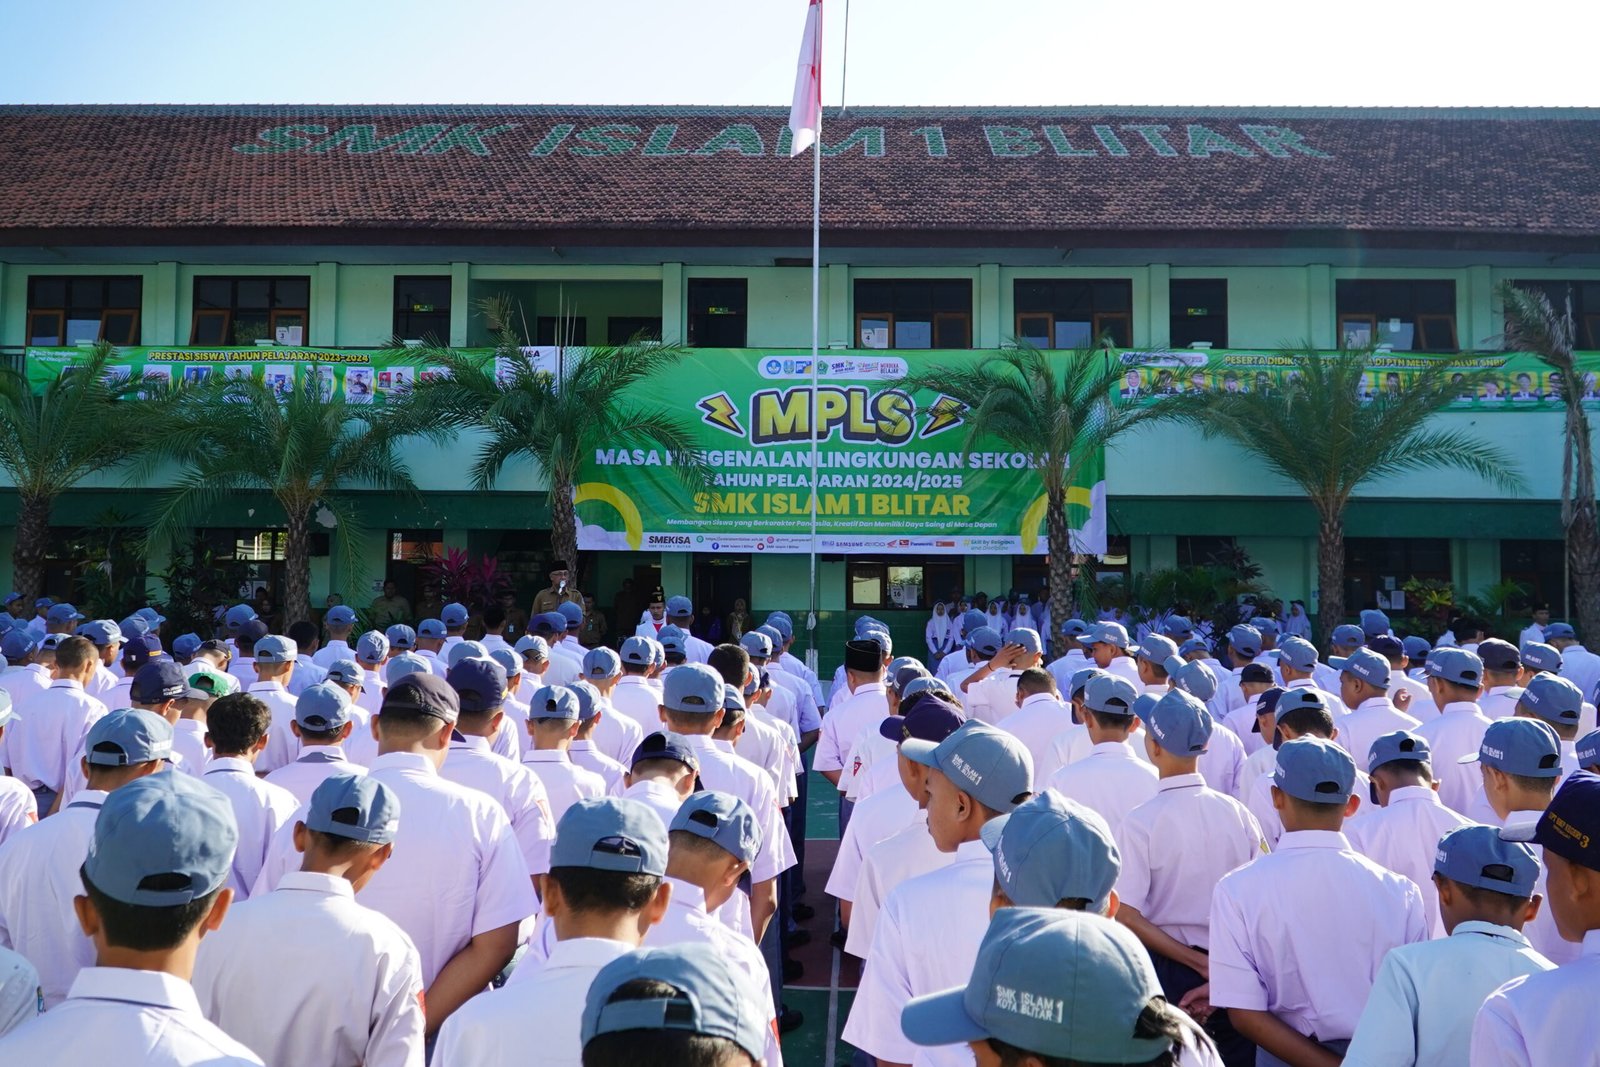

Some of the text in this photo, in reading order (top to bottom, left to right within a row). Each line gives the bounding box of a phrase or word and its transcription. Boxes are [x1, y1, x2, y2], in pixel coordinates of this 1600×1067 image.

[232, 123, 1336, 159] SMK ISLAM 1 BLITAR
[148, 351, 369, 363] PRESTASI SISWA TAHUN PELAJARAN 2023-2024
[1224, 355, 1266, 365] PESERTA
[1267, 356, 1294, 366] DIDIK
[1375, 358, 1385, 366] DI
[1386, 358, 1405, 366] PTN
[1406, 359, 1443, 367] MELAL
[831, 361, 845, 370] SMK
[753, 387, 914, 445] MPLS
[595, 449, 1070, 469] MASA PNGENALAN LINGKUNGAN SEKOL
[766, 473, 869, 488] PELAJARAN
[871, 471, 964, 492] 2024/2025
[693, 492, 971, 516] SMK ISLAM 1 BLITAR
[666, 519, 712, 527] Membangun
[734, 520, 753, 529] yang
[648, 536, 691, 544] SMEKISA
[1579, 835, 1590, 848] 3
[996, 985, 1064, 1024] SMK ISLAM 1
[996, 998, 1052, 1021] KOTA BLITAR
